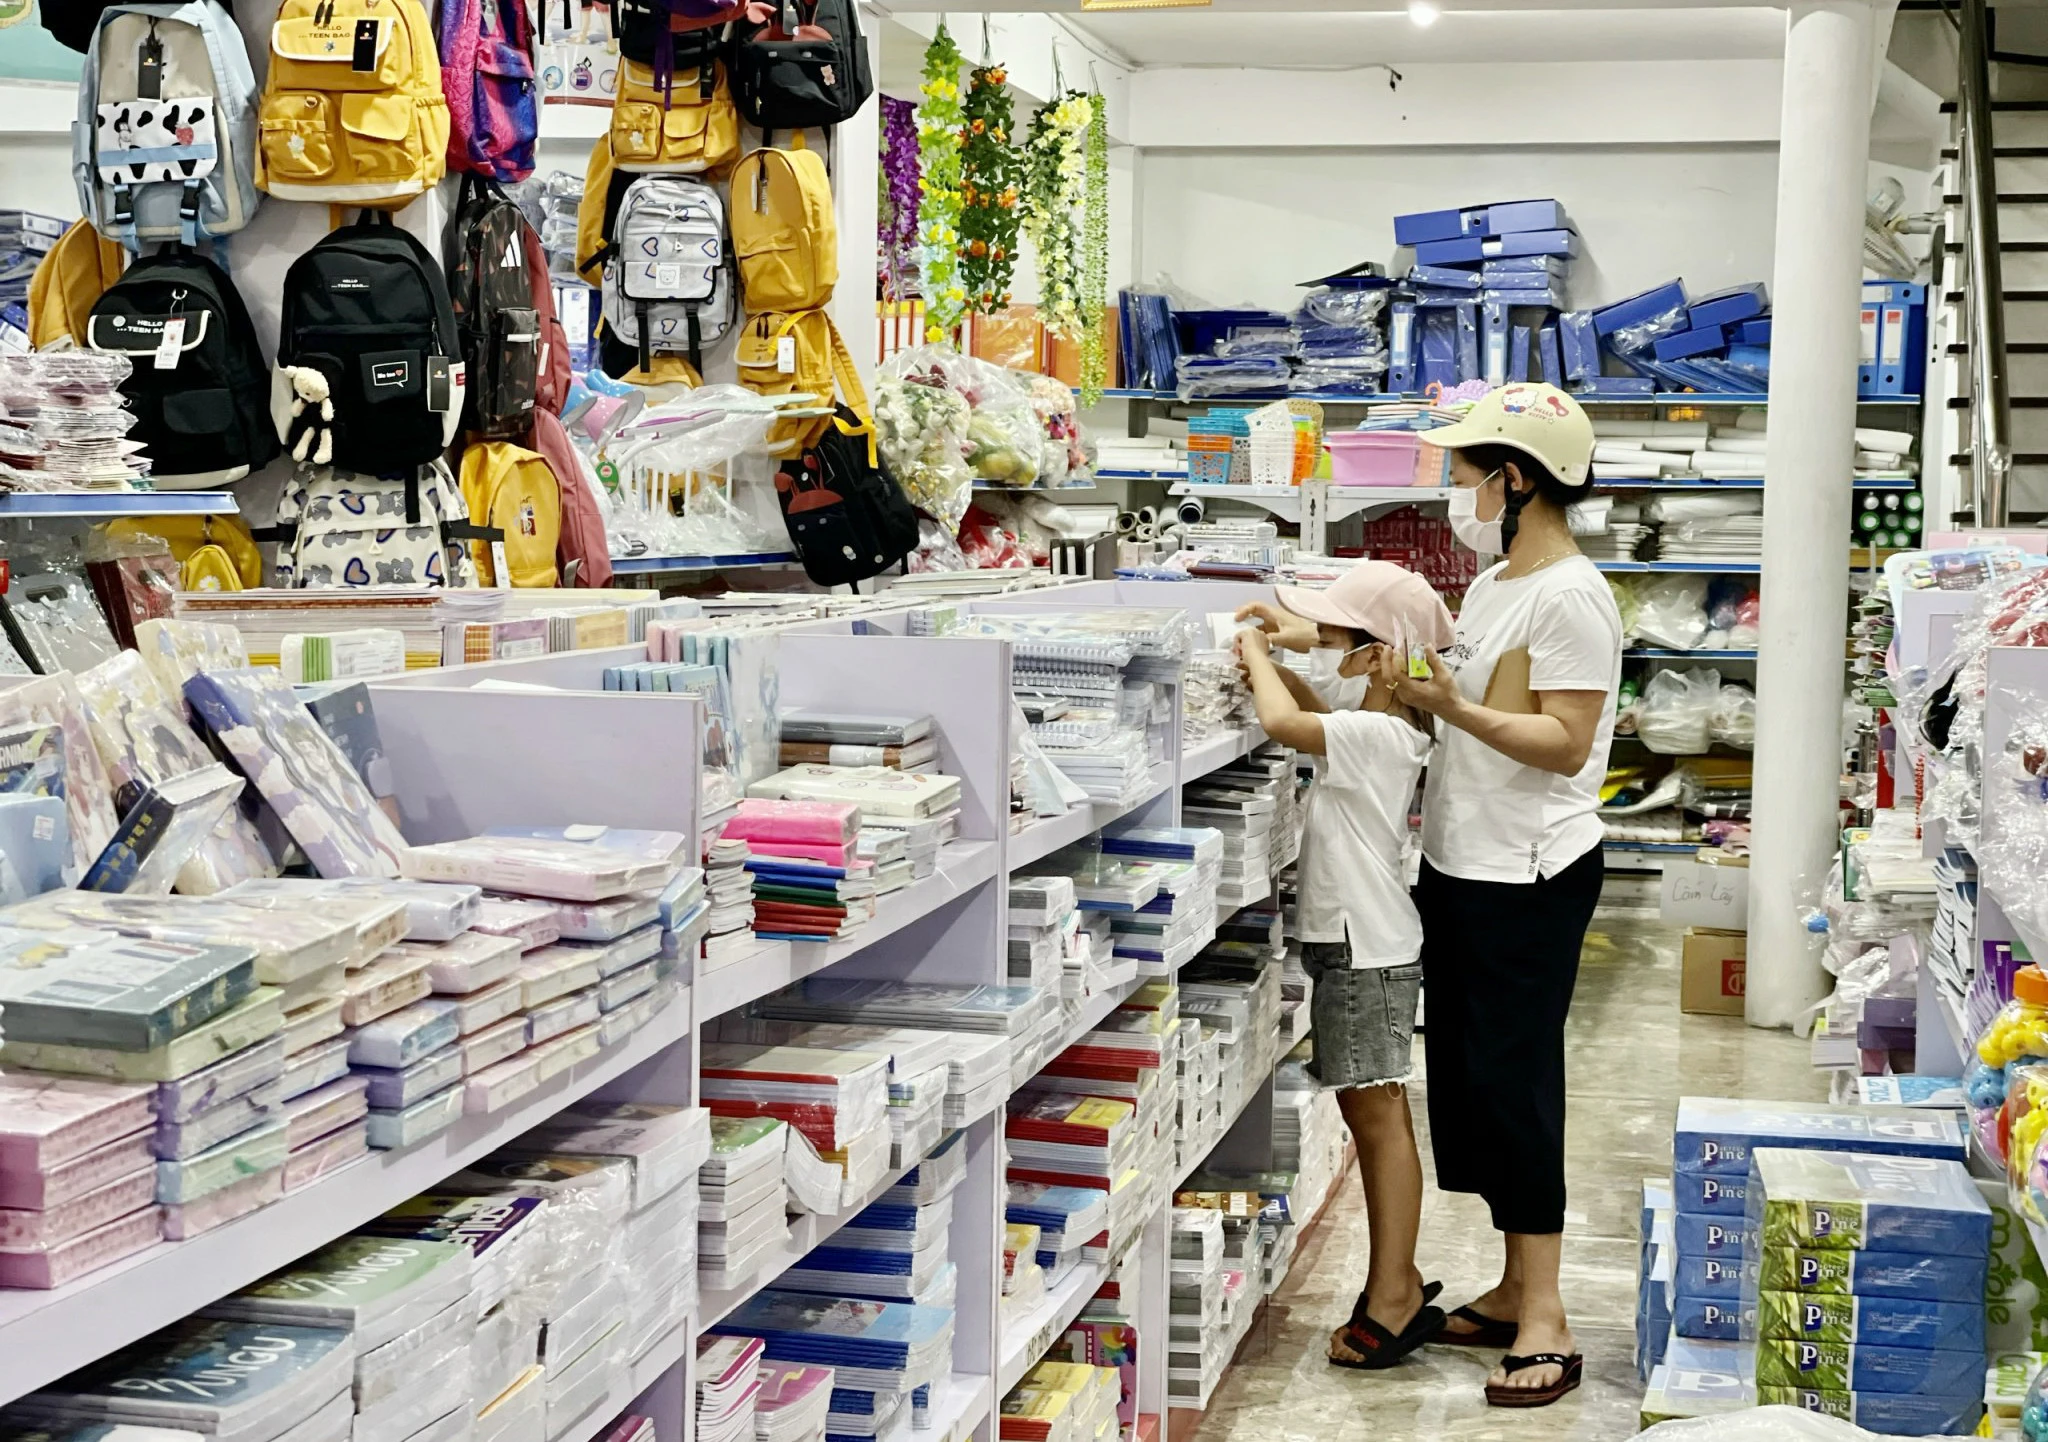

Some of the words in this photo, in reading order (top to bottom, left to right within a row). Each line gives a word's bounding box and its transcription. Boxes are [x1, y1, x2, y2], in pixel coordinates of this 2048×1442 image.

[136, 319, 164, 327] HELLO
[1703, 1141, 1745, 1161] Pine
[1703, 1180, 1745, 1199] Pine
[1815, 1210, 1859, 1232] Pine
[1801, 1258, 1846, 1279] Pine
[1805, 1305, 1849, 1326] Pine
[1801, 1344, 1846, 1365] Pine
[1804, 1393, 1848, 1413] Pine
